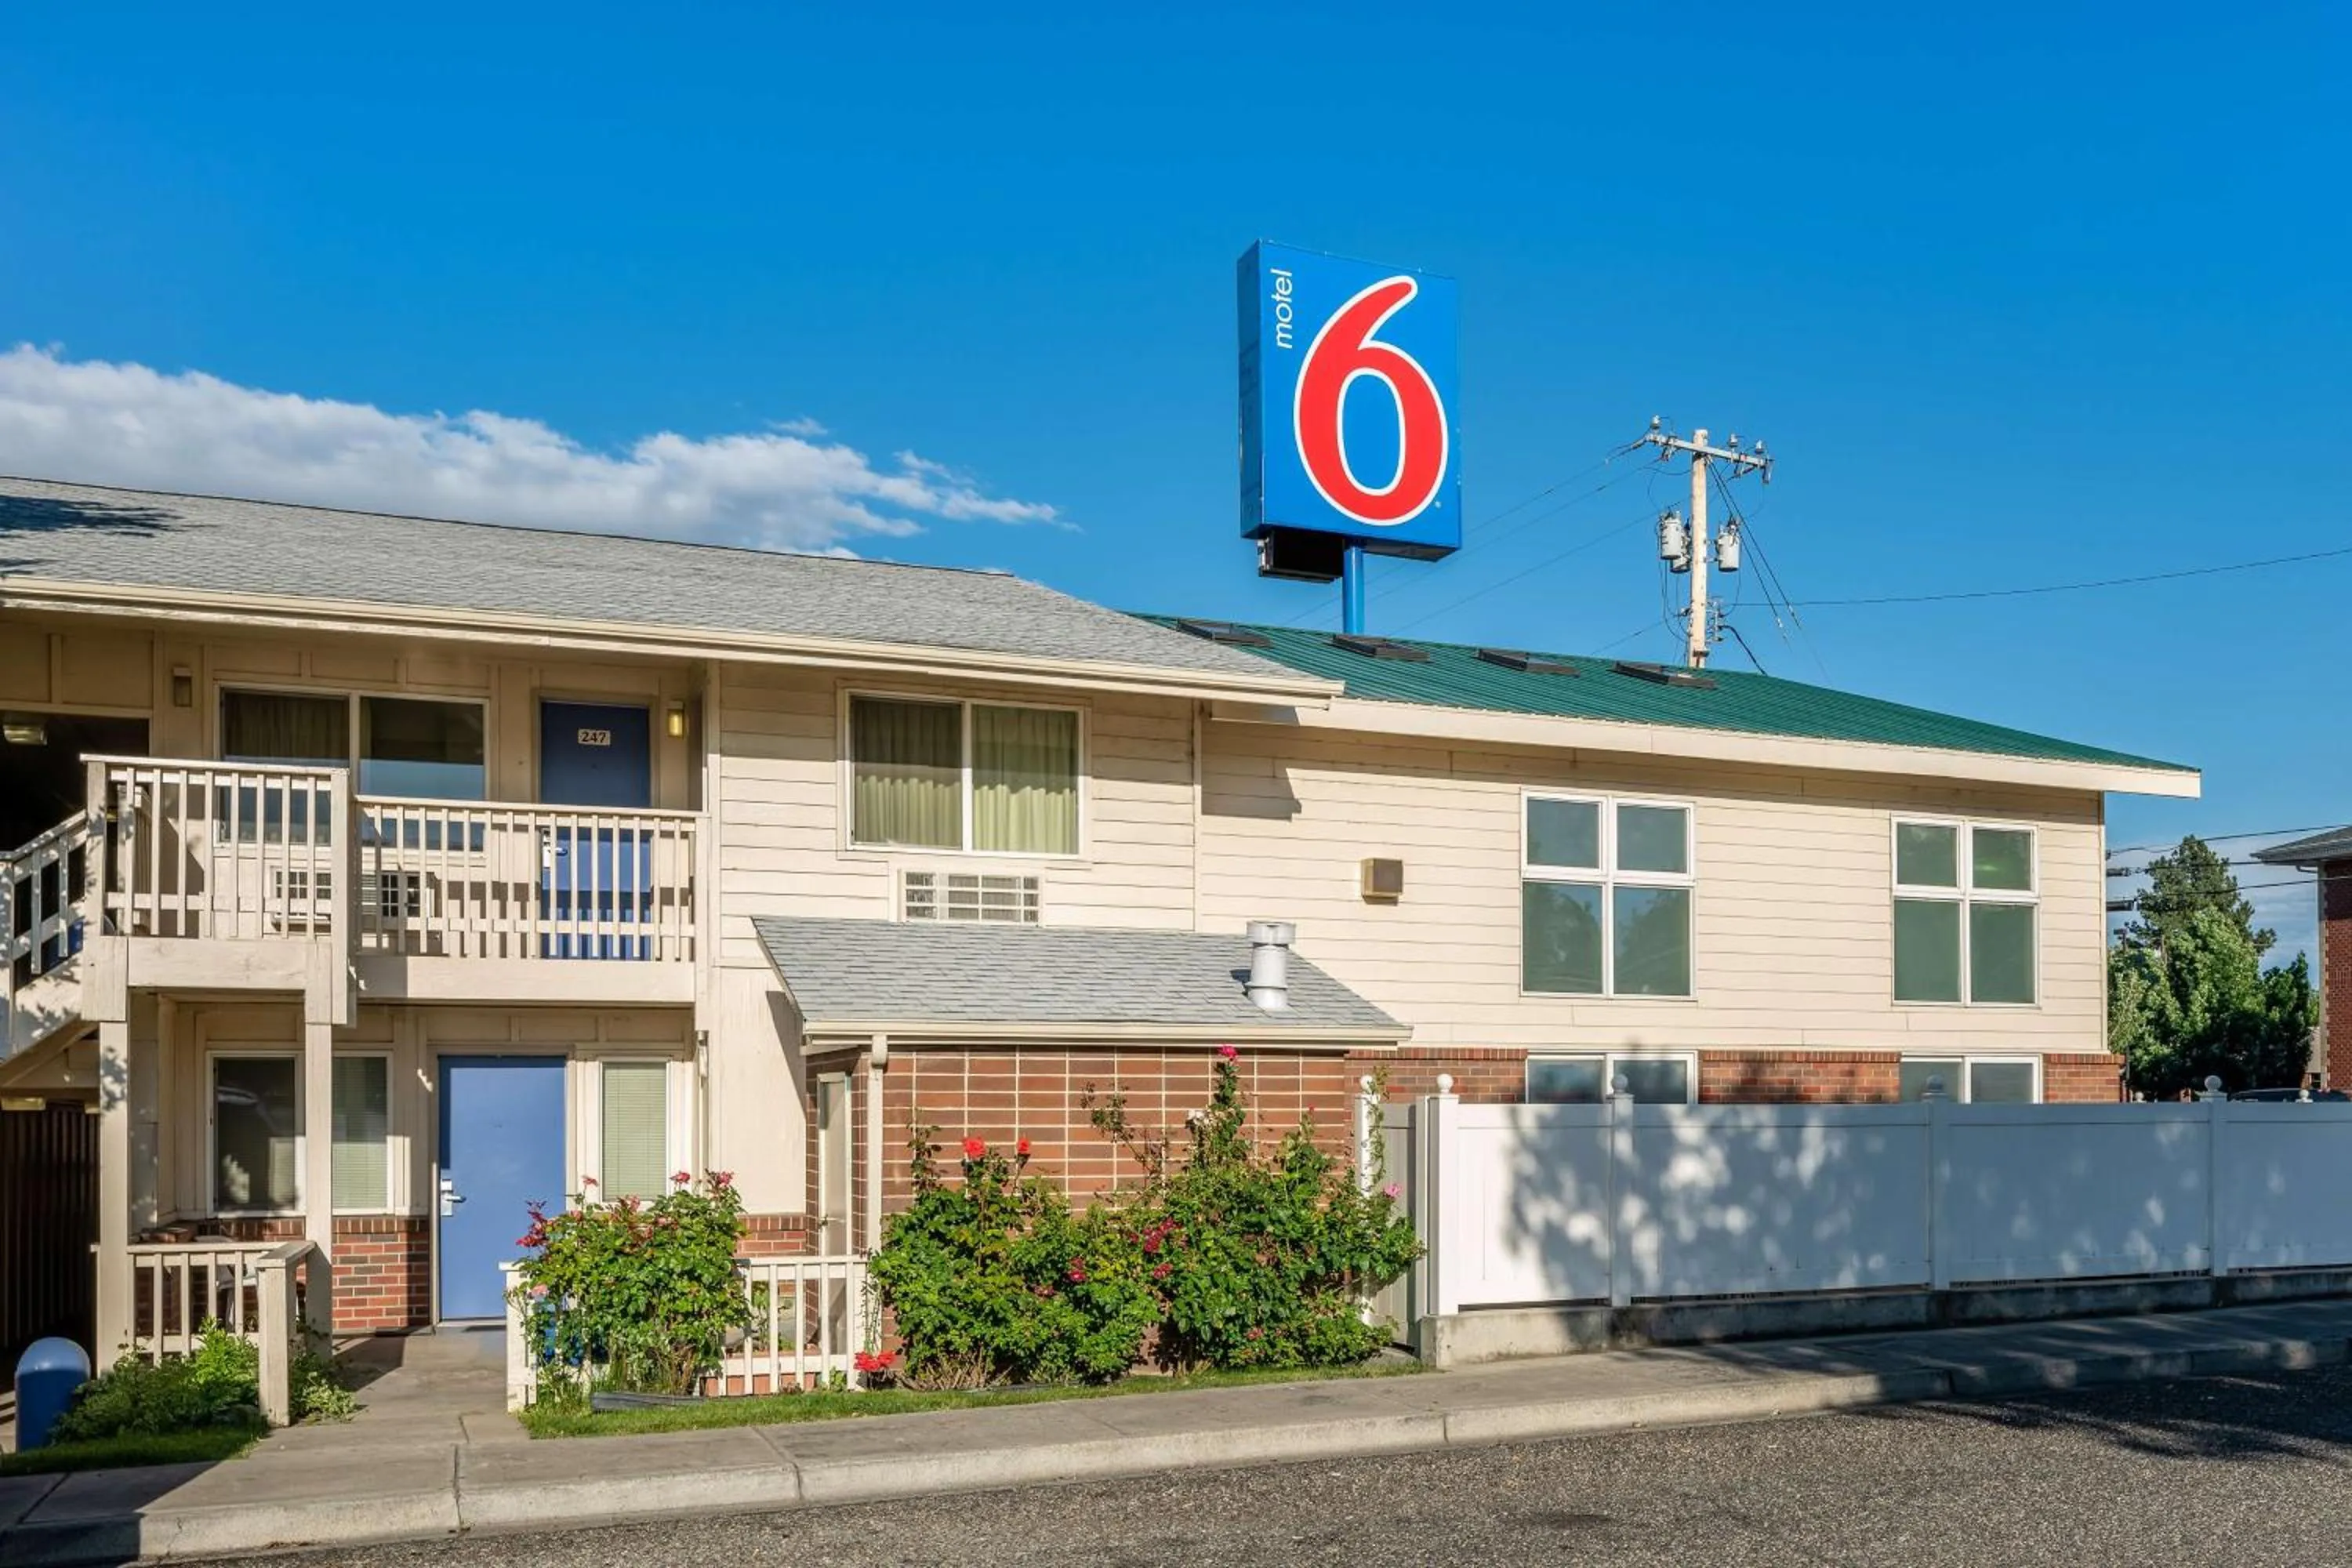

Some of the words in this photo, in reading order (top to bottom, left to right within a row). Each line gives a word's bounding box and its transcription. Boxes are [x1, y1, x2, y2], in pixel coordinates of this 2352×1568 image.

[1270, 268, 1293, 350] motel
[1294, 275, 1448, 526] 6
[581, 731, 606, 743] 247
